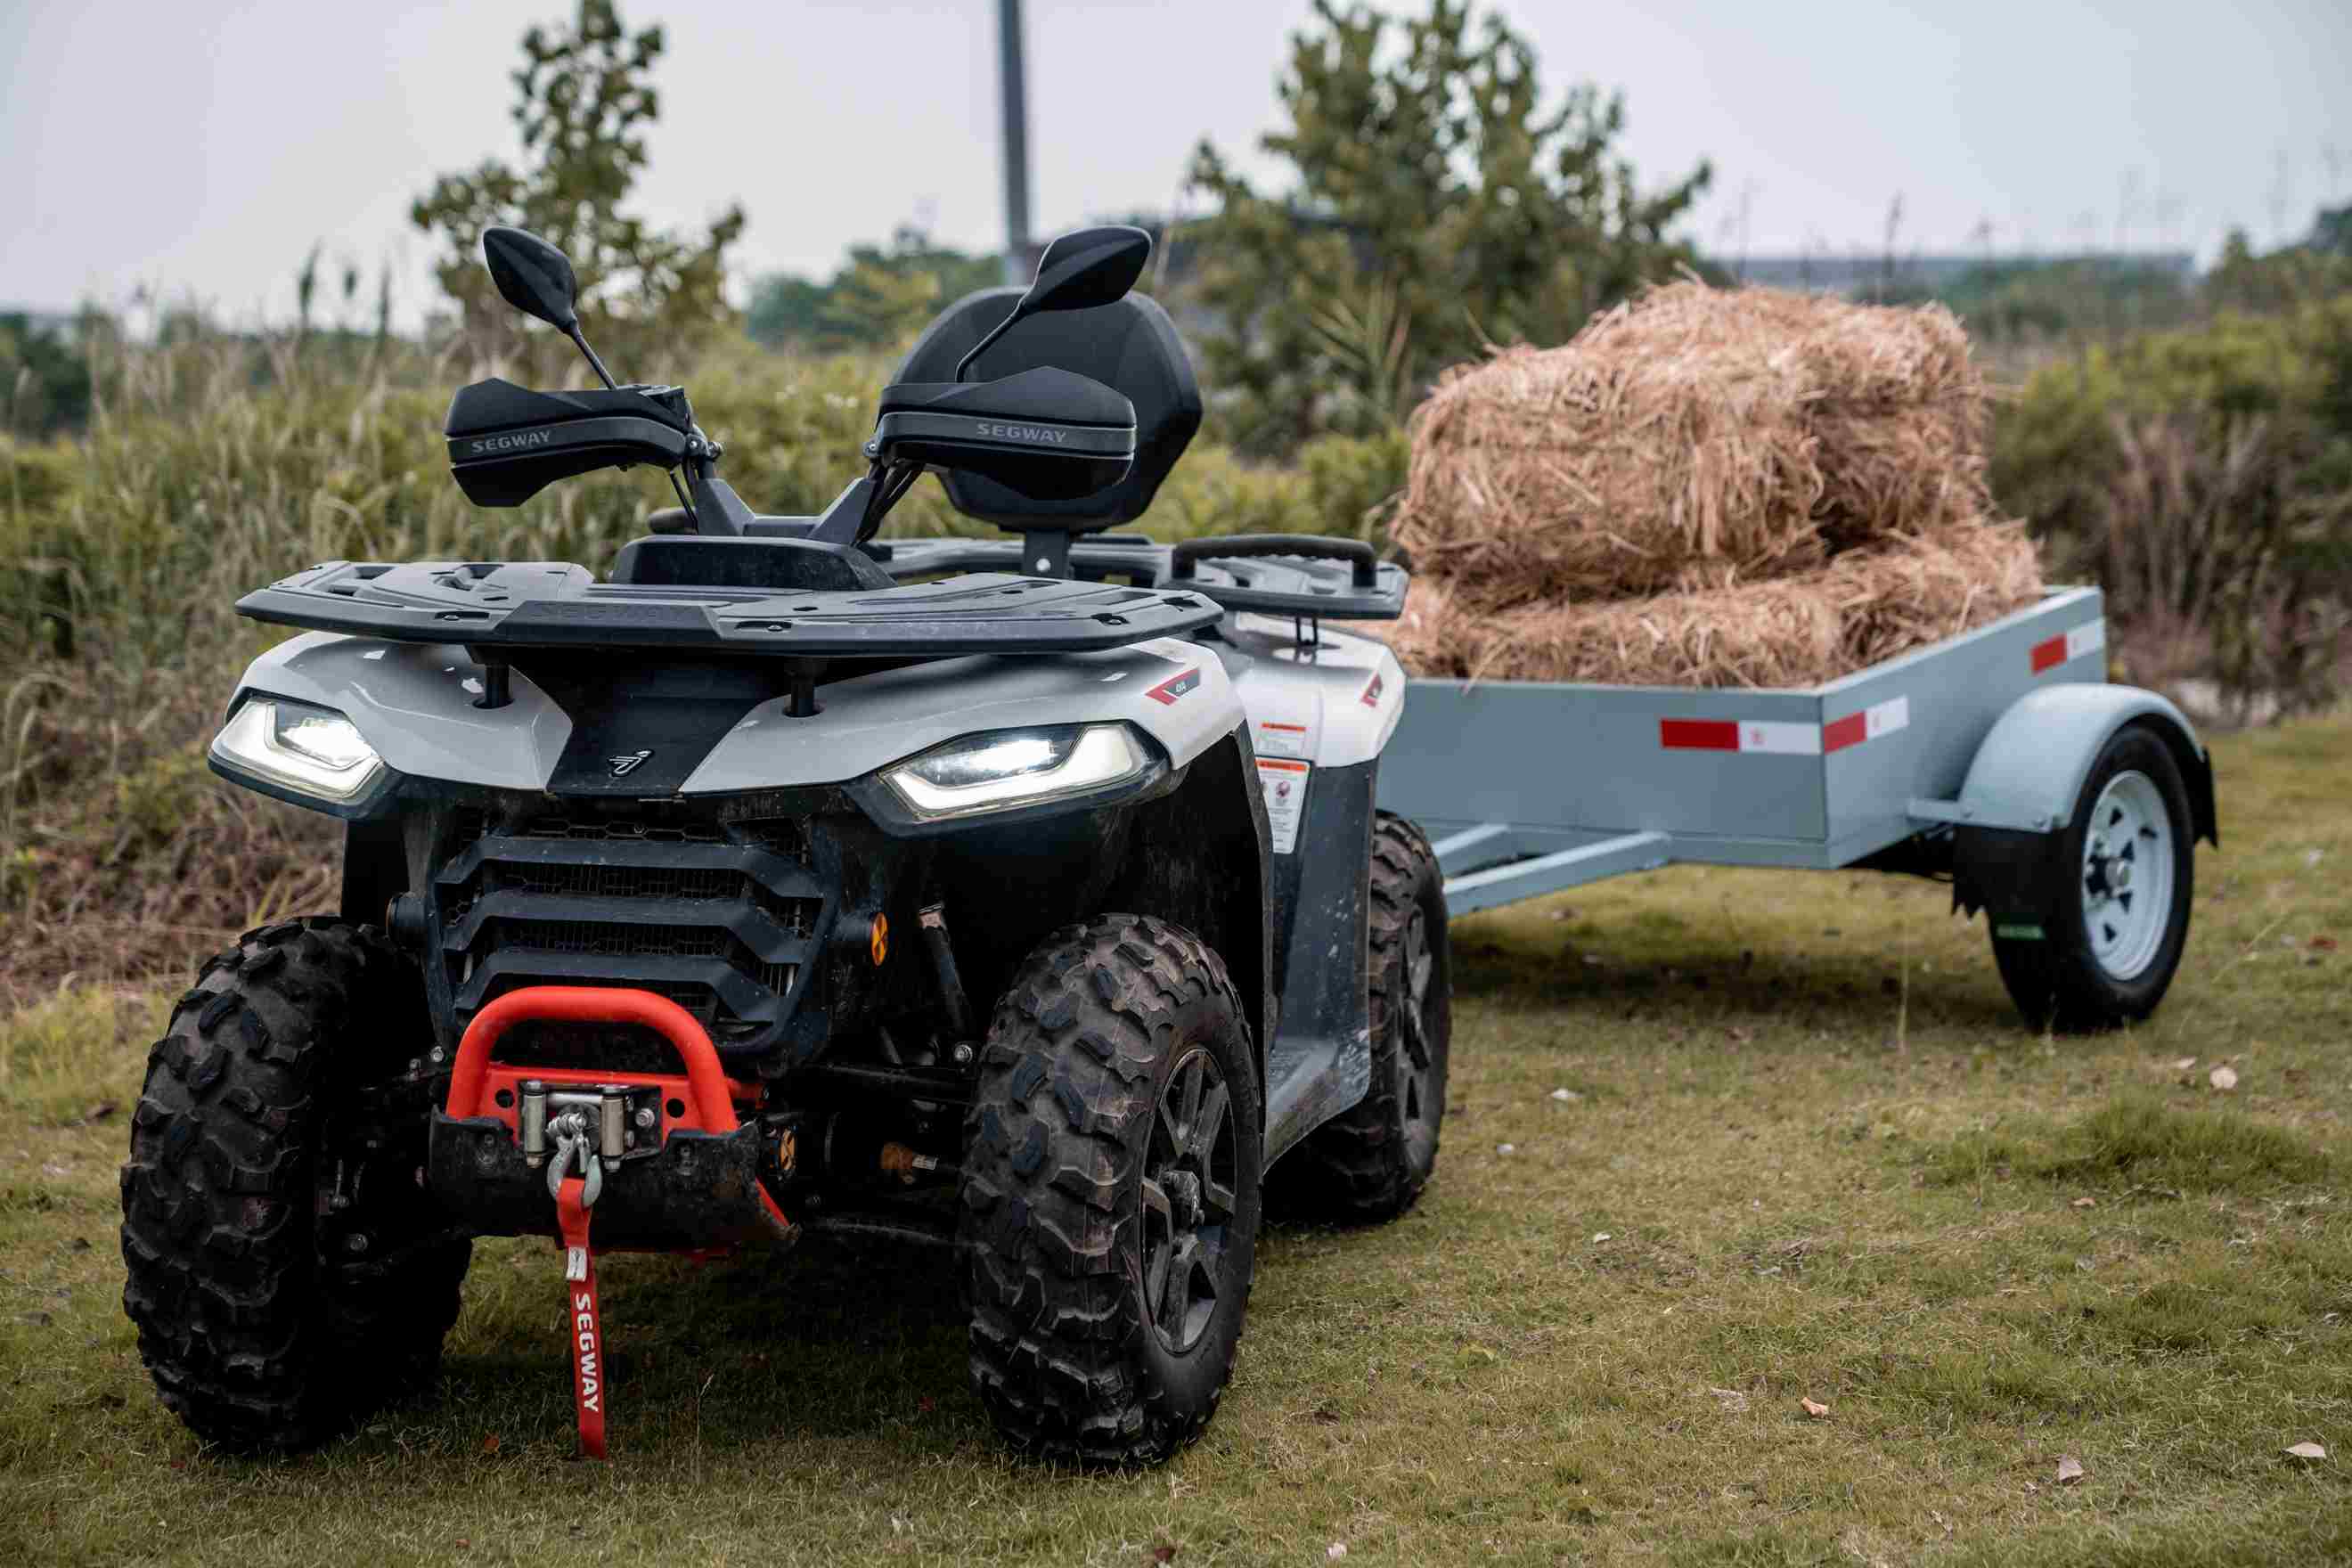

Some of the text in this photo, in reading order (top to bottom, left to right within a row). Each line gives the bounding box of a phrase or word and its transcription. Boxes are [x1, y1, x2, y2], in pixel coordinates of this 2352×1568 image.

[471, 430, 551, 453] SEGWAY
[976, 423, 1066, 443] SEGWAY
[577, 1293, 599, 1412] SEGWAY
